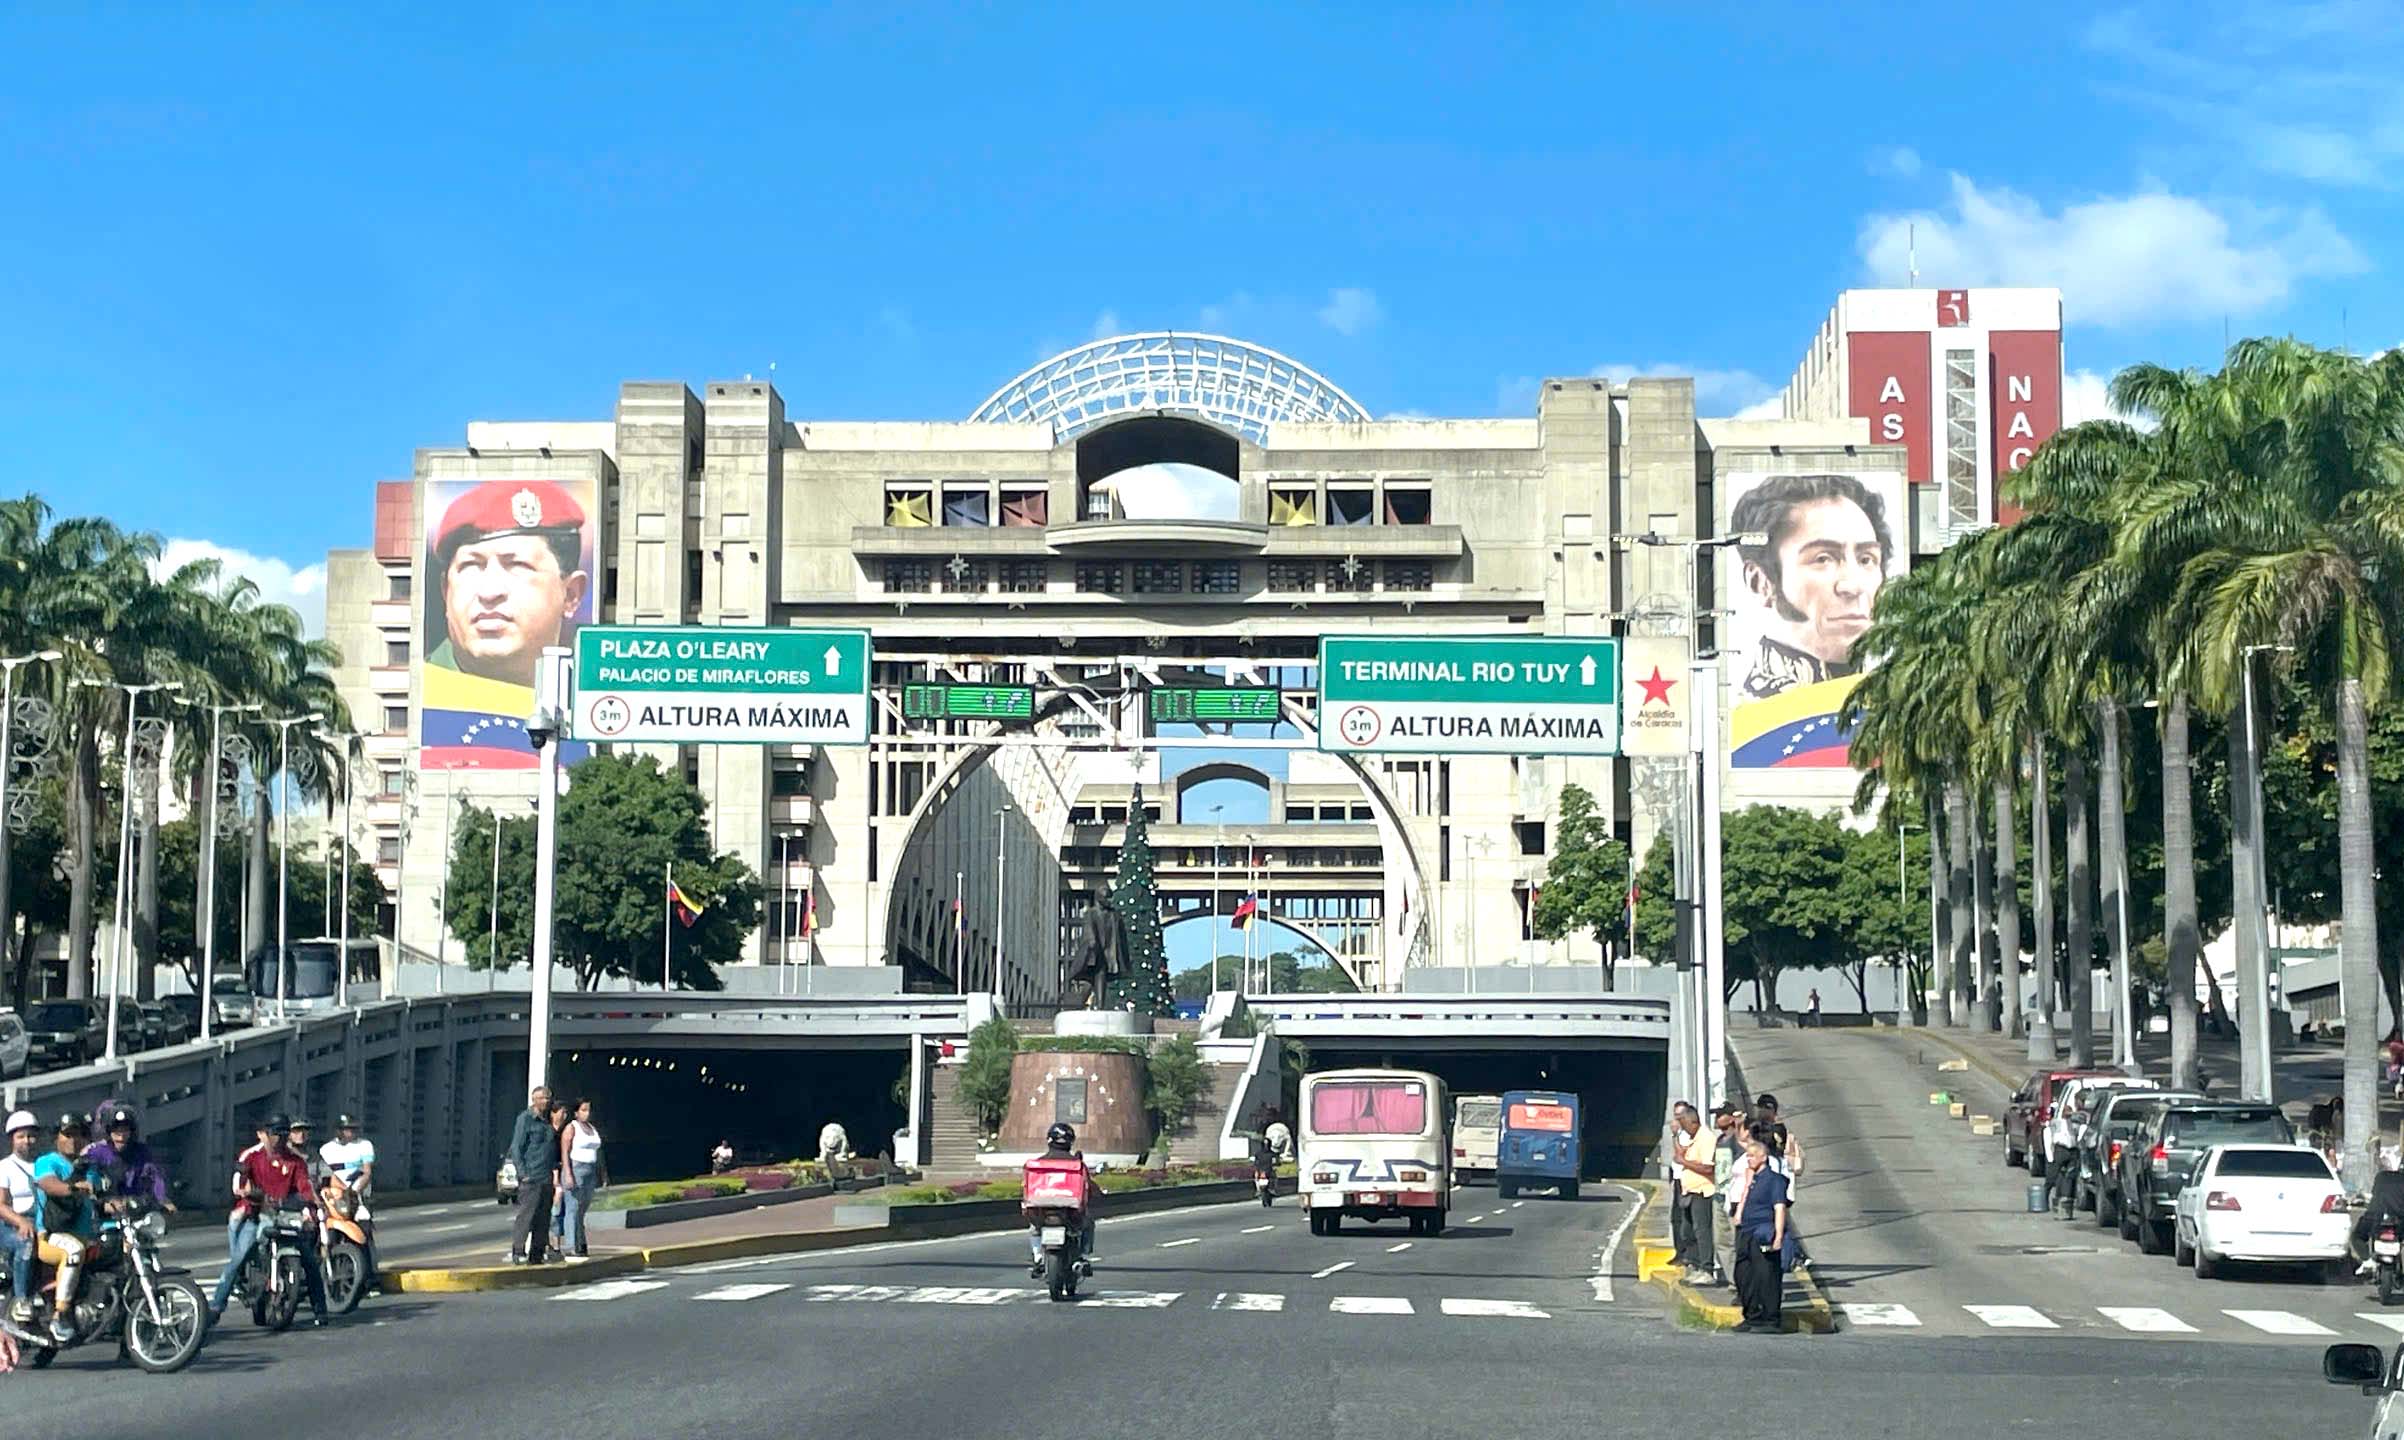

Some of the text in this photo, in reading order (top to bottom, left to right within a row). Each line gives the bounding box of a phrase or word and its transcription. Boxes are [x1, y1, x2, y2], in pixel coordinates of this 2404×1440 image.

[600, 639, 771, 661] PLAZA O'LEARY
[599, 667, 811, 685] PALACIO DE MIRAFLORES
[1339, 660, 1571, 684] TERMINAL RIO TUY
[639, 702, 850, 729] ALTURA MÁXIMA
[1390, 712, 1604, 739] ALTURA MÁXIMA
